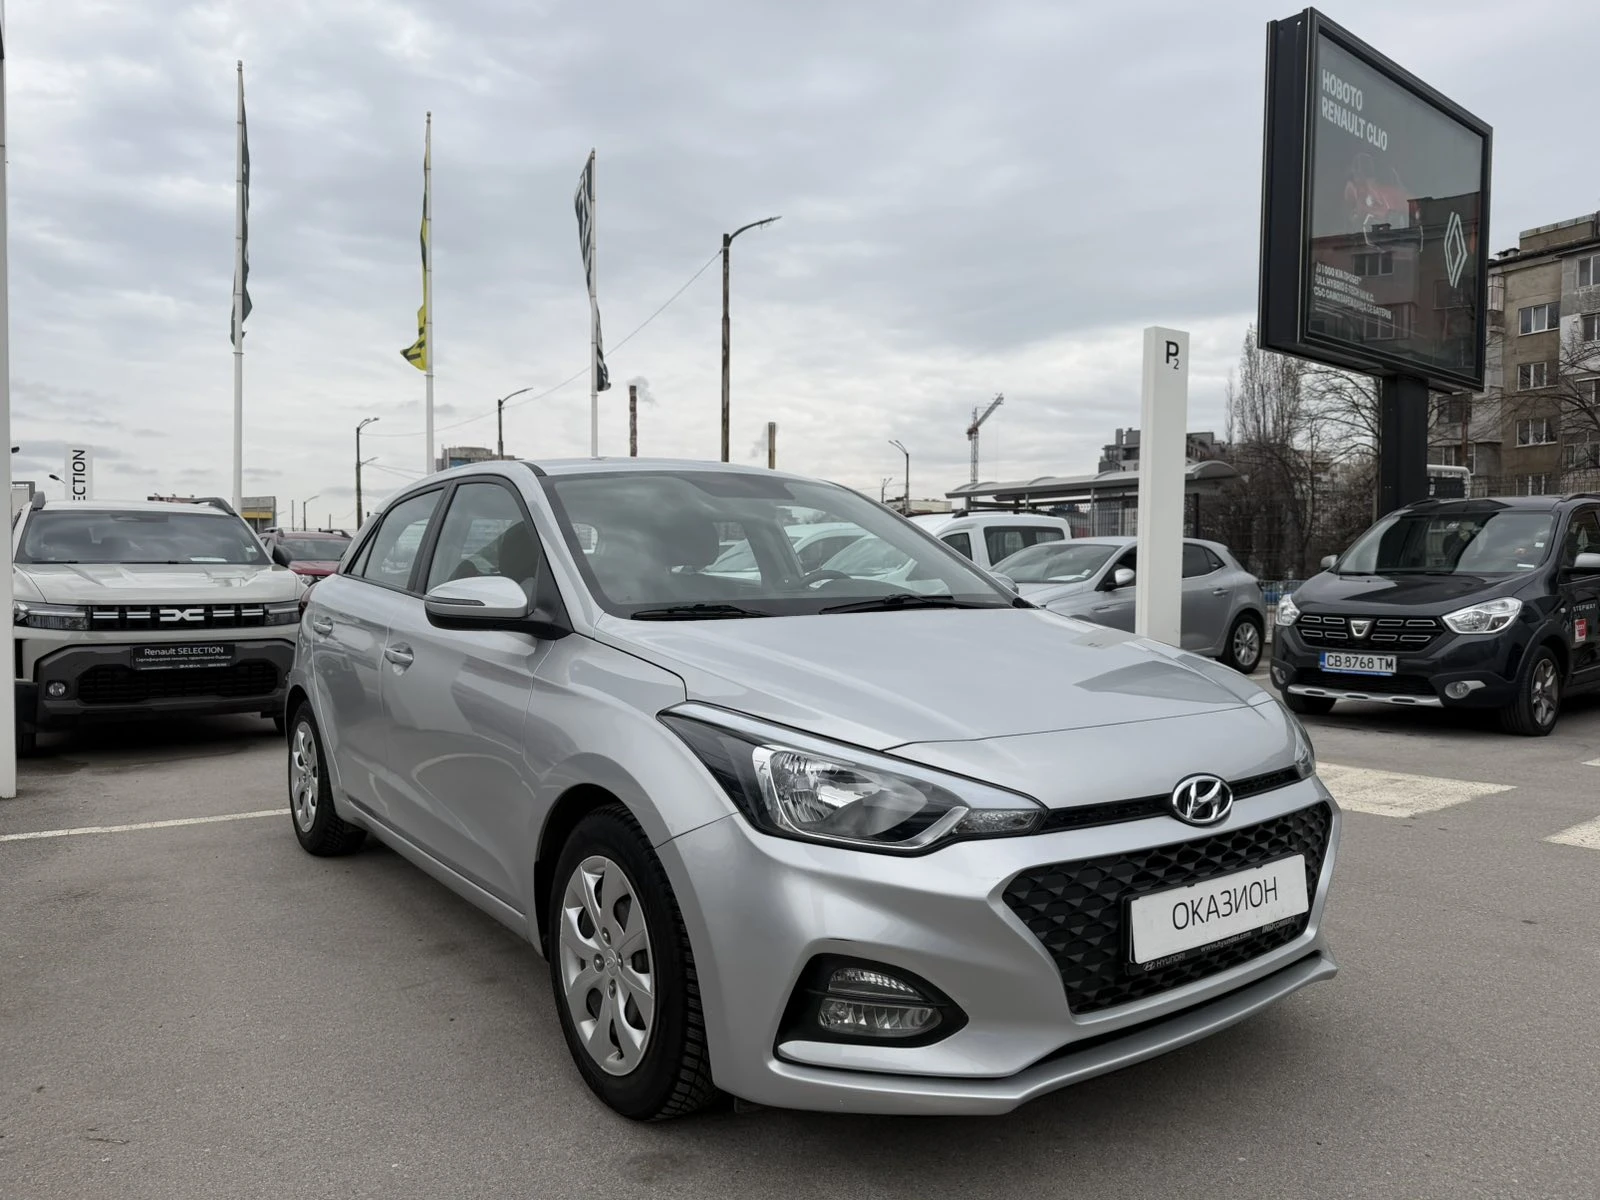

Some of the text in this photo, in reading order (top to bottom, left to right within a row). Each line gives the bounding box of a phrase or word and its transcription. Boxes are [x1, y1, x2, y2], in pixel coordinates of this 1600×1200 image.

[1322, 69, 1363, 111] НОВОТО
[1321, 96, 1388, 151] RENAULT CLIO
[144, 646, 224, 656] Renault SELECTION
[1344, 656, 1375, 670] 8768
[1377, 657, 1394, 671] TM
[1172, 876, 1278, 930] ОКАЗИОН
[1156, 952, 1186, 968] HYUNDAI
